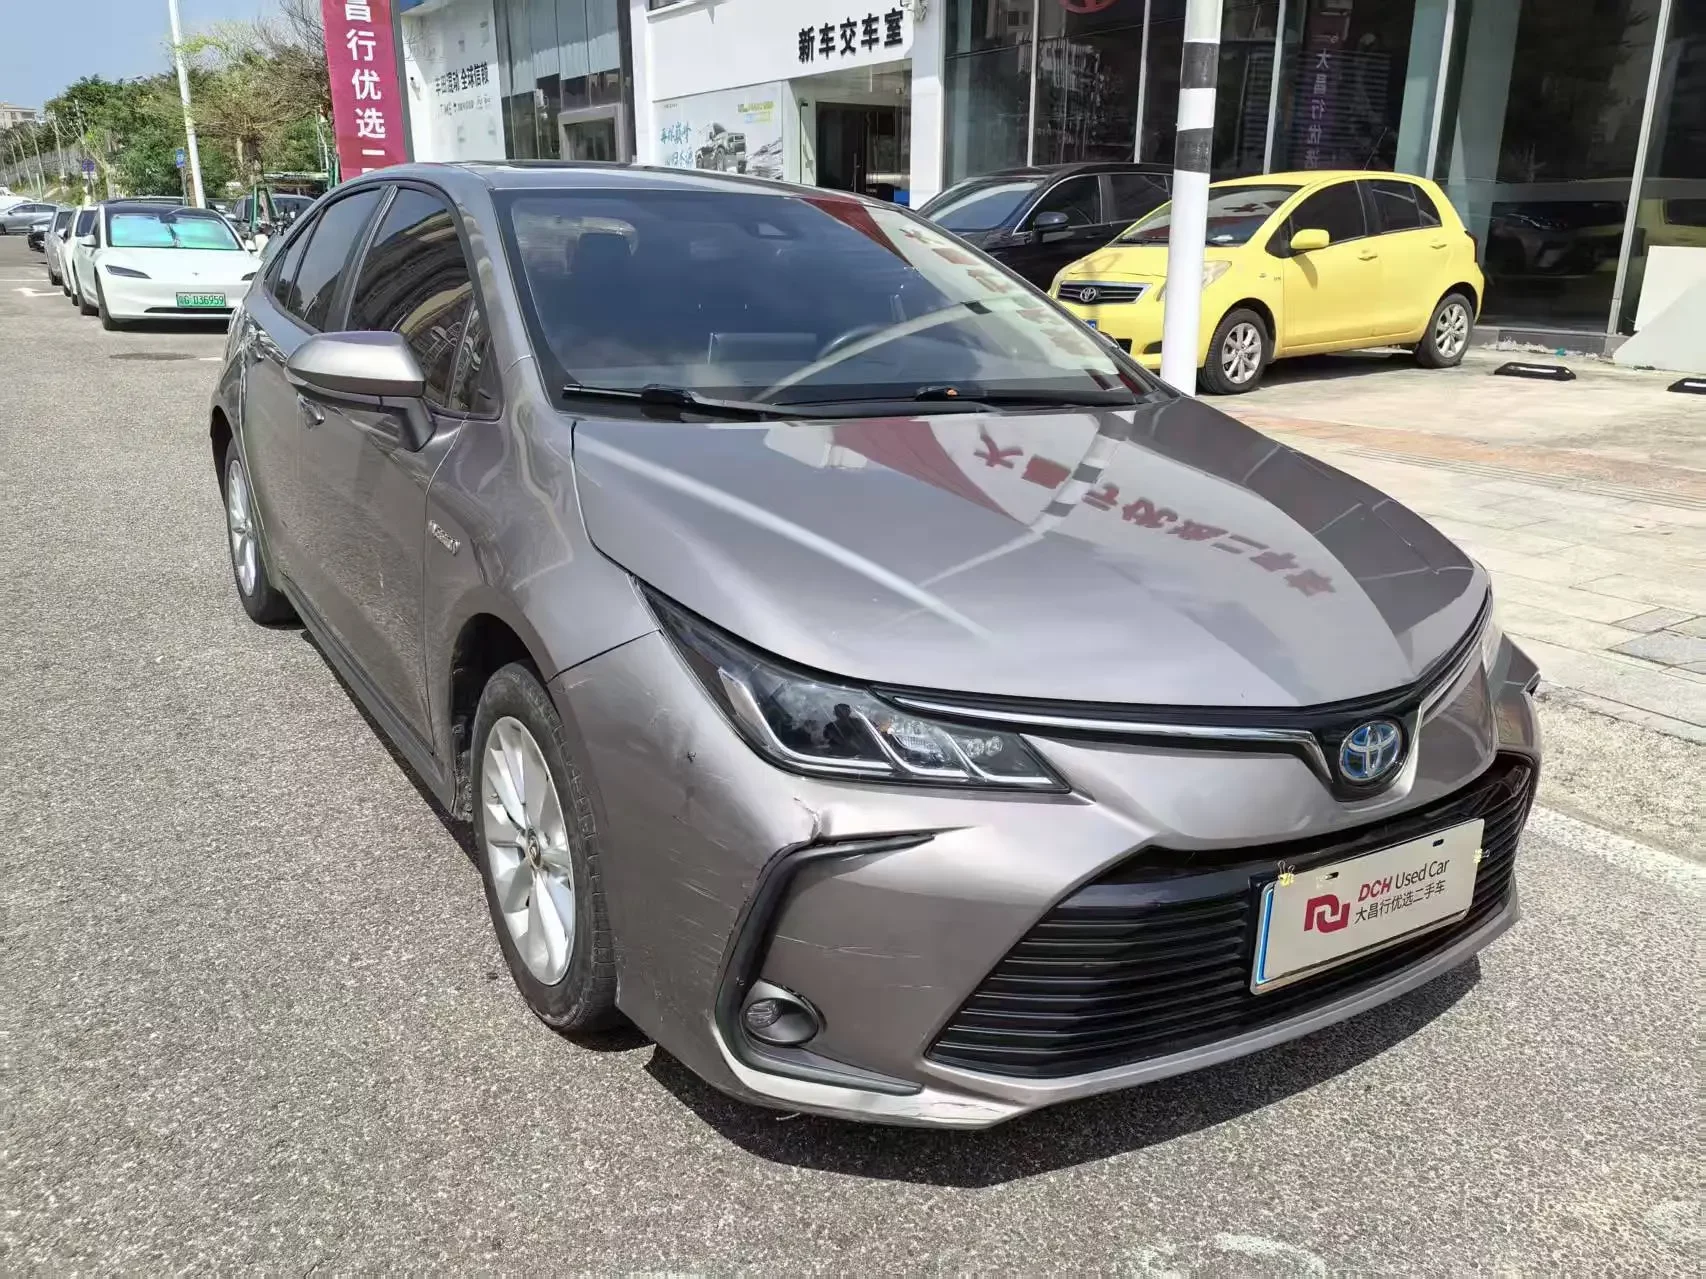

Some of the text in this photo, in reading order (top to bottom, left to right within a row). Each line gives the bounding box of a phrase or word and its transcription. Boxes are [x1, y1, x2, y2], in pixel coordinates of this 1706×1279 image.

[798, 8, 903, 63] 新车交车室
[1354, 880, 1446, 924] 大昌行优选二手车
[1358, 860, 1450, 902] DCH Used Car
